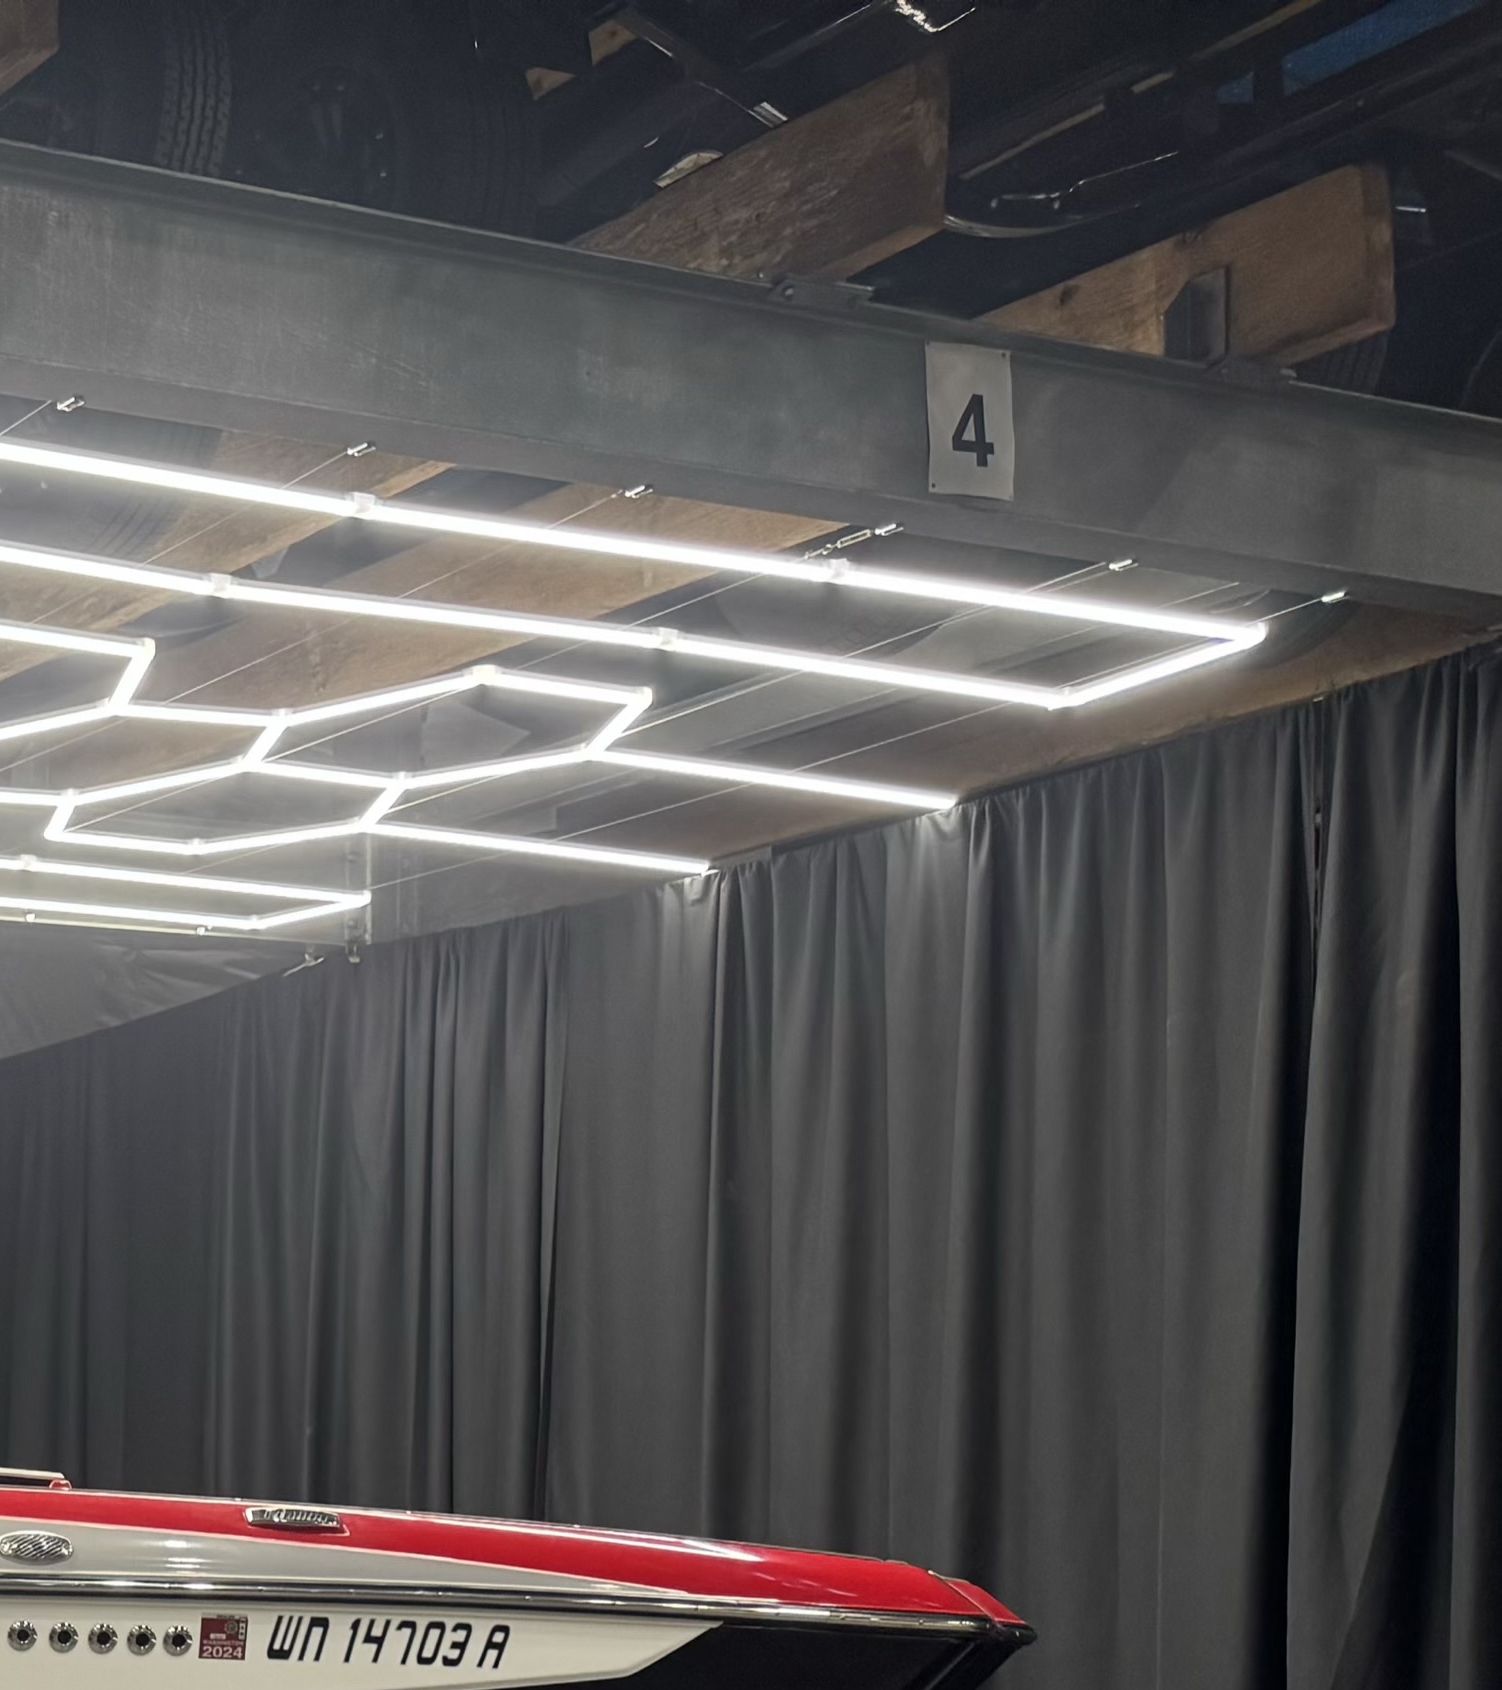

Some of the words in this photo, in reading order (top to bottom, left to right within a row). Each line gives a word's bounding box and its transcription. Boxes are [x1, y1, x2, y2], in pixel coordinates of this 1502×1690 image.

[951, 393, 995, 468] 4
[202, 1645, 243, 1659] 2024
[342, 1617, 472, 1667] 14703
[476, 1623, 512, 1669] A
